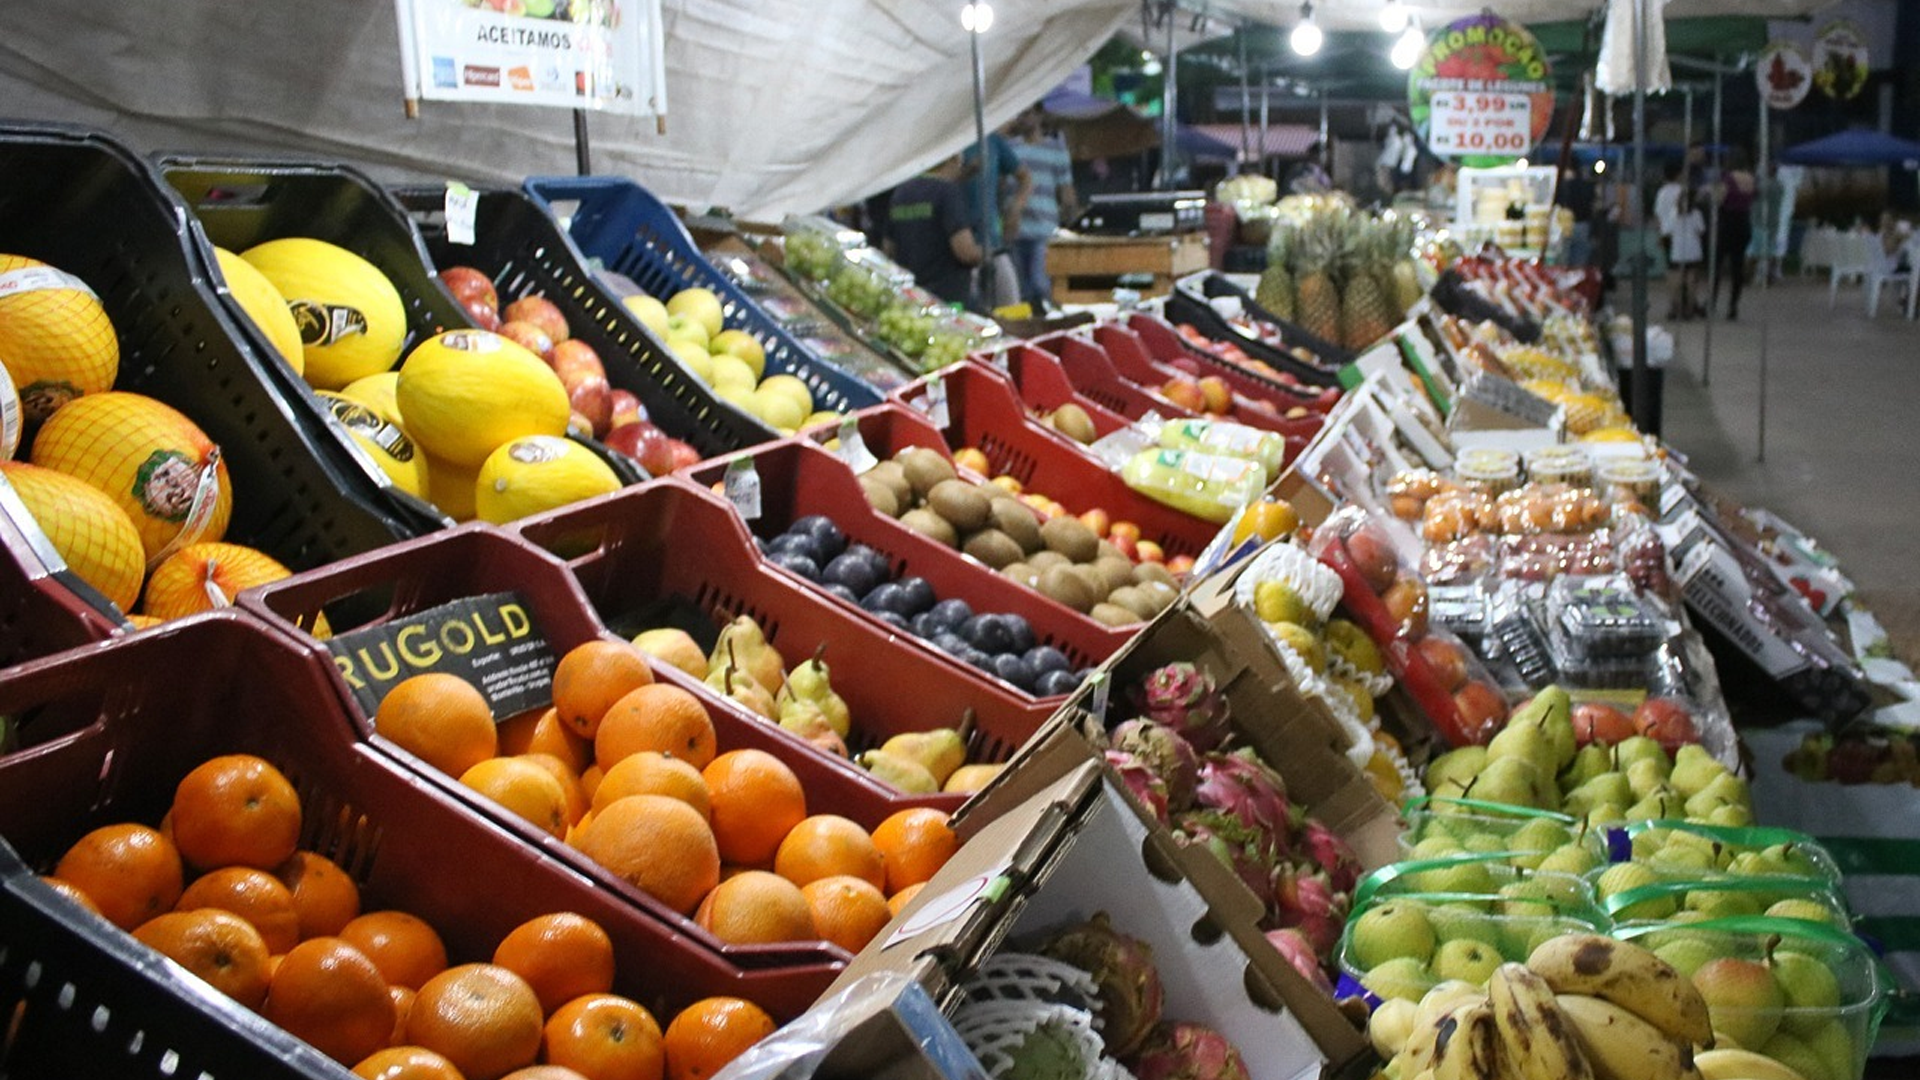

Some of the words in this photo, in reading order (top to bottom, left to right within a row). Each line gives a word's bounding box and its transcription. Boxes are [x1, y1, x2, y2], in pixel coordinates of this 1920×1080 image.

[477, 24, 572, 50] ACEITAMOS
[1453, 96, 1506, 114] 3,99
[1455, 133, 1524, 151] 10,00
